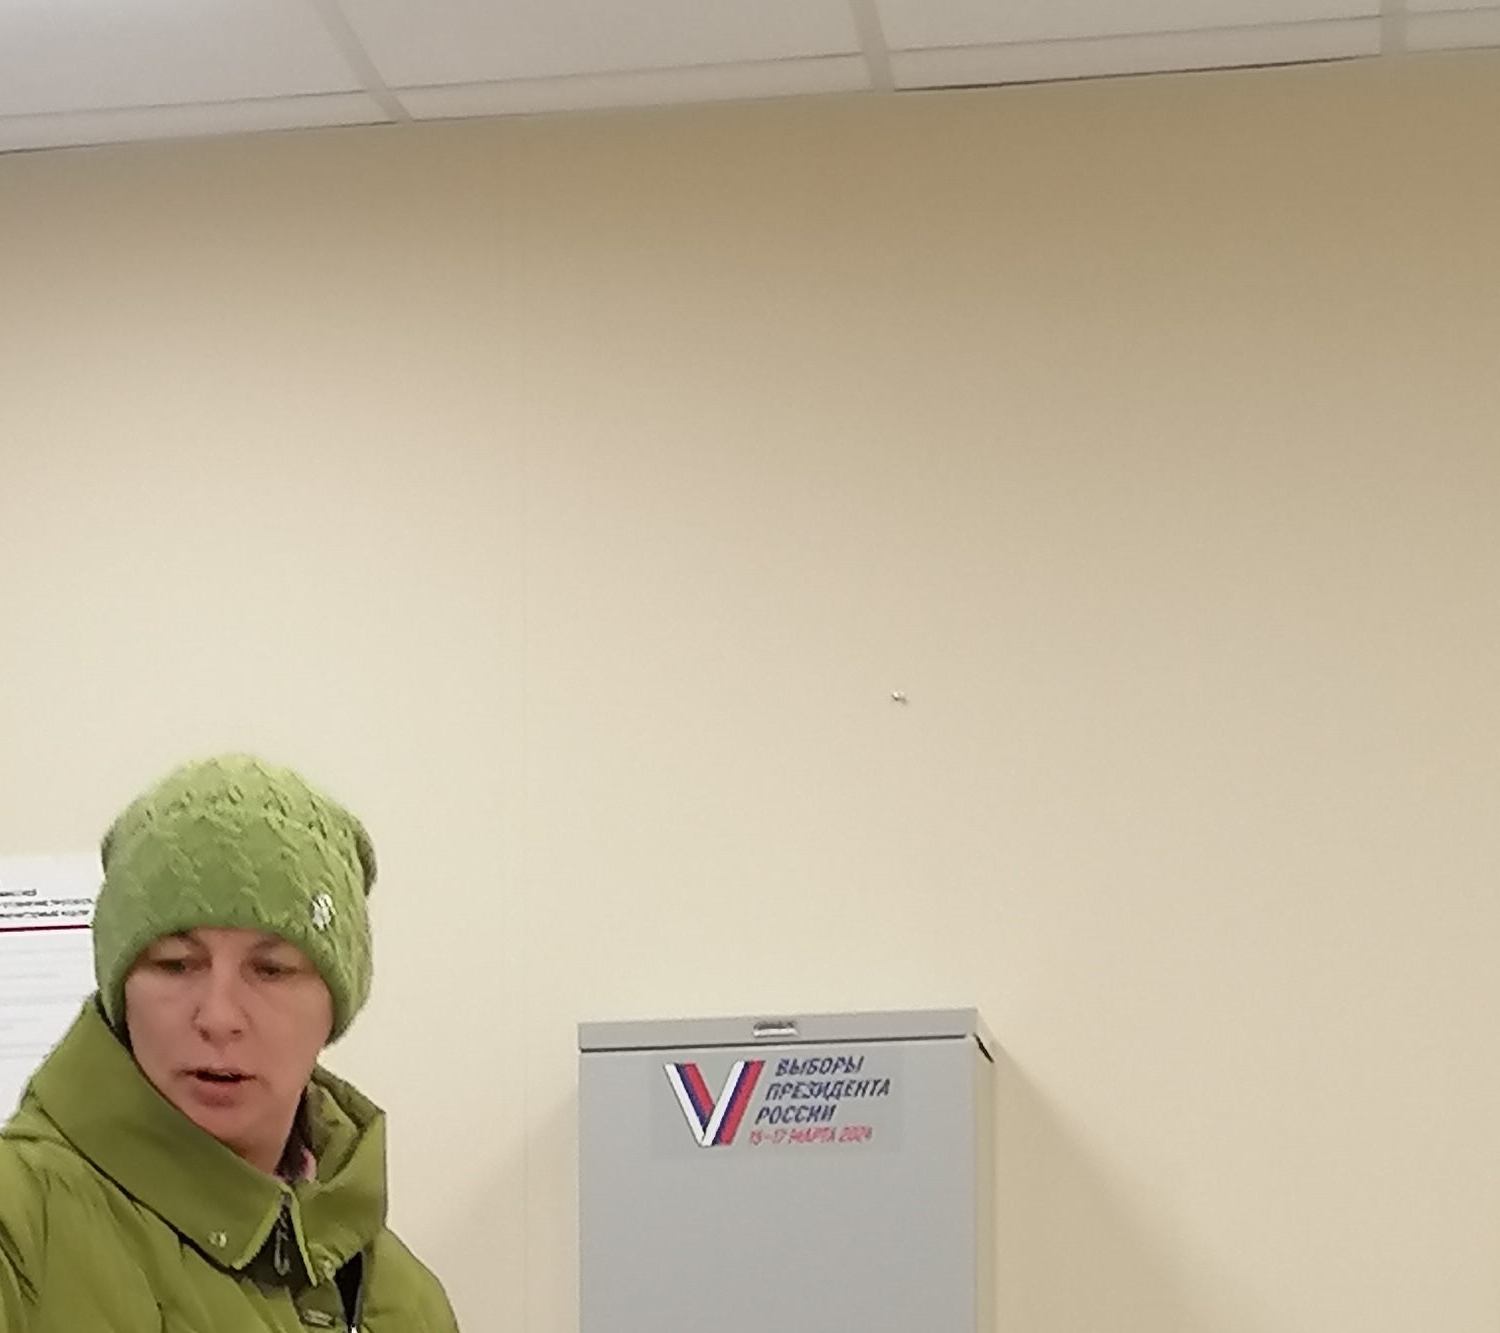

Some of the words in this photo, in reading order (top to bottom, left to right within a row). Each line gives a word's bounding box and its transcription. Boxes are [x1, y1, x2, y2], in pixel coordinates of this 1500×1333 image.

[774, 1055, 866, 1077] ВЫБОРЫ
[765, 1078, 891, 1101] ПРЕЗИДЕНТА
[754, 1104, 837, 1125] РОССИИ
